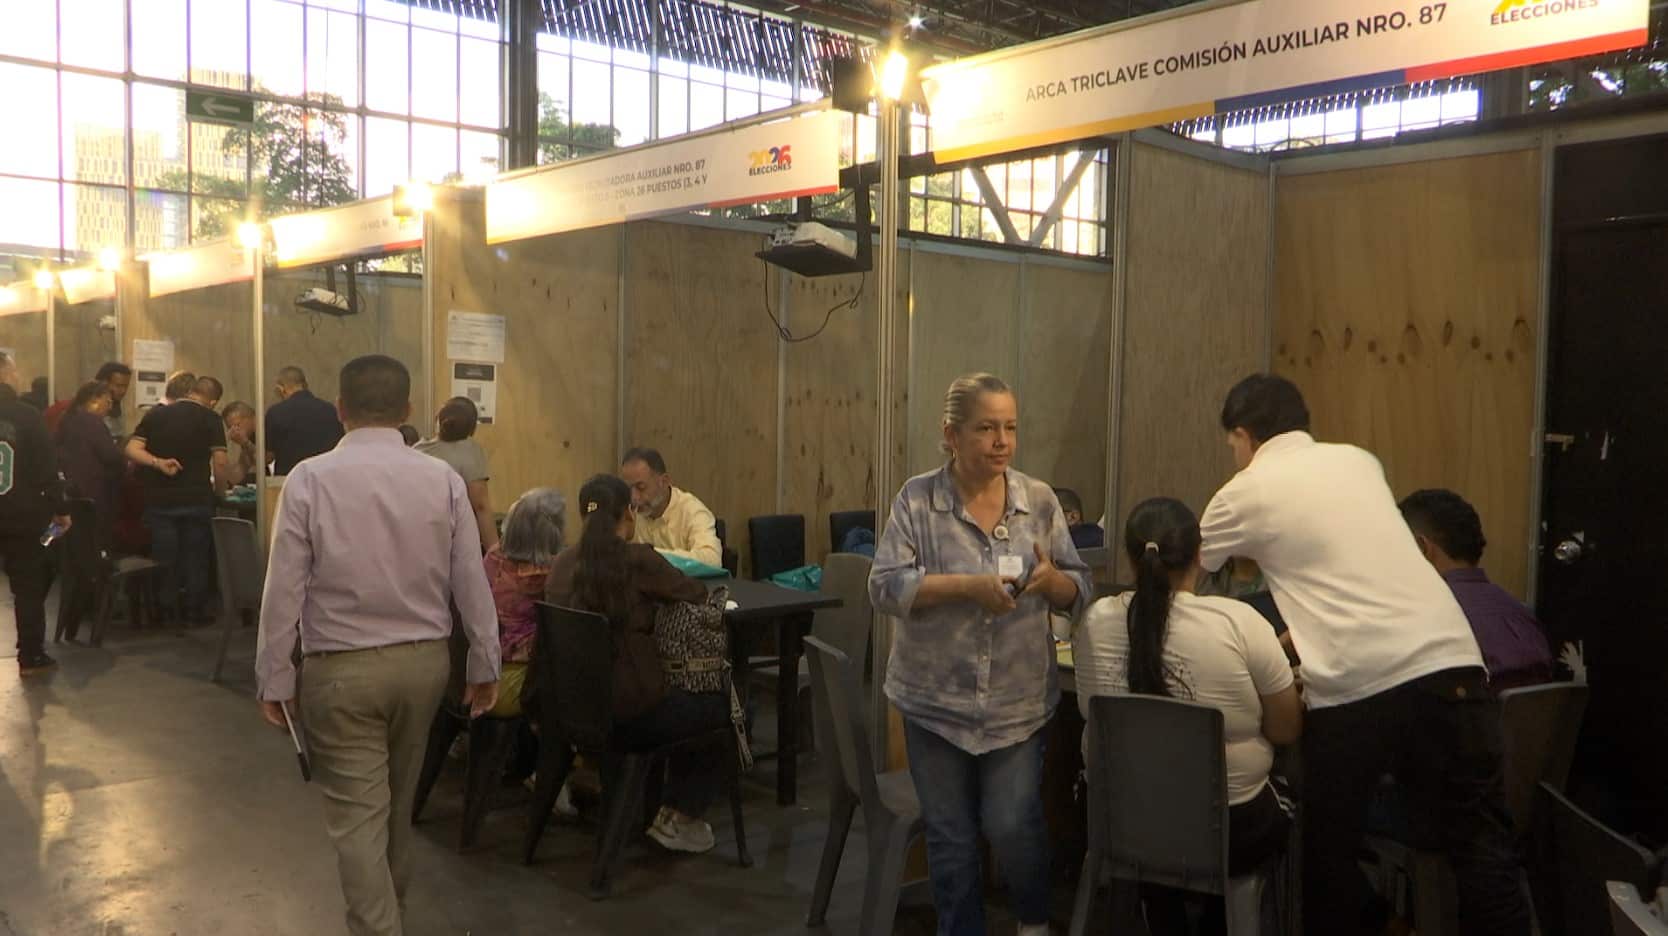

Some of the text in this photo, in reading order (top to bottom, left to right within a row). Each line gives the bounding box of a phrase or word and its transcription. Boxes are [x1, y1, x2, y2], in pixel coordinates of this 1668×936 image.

[1490, 0, 1599, 25] ELECCIONES
[1026, 3, 1447, 102] ARCA TRICLAVE COMISIÓN AUXILIAR NRO. 87
[637, 165, 672, 181] AUXILIAR
[673, 161, 694, 176] NRO.
[695, 159, 706, 171] 87
[748, 161, 792, 177] ELECCIONES
[647, 179, 682, 194] PUESTOS
